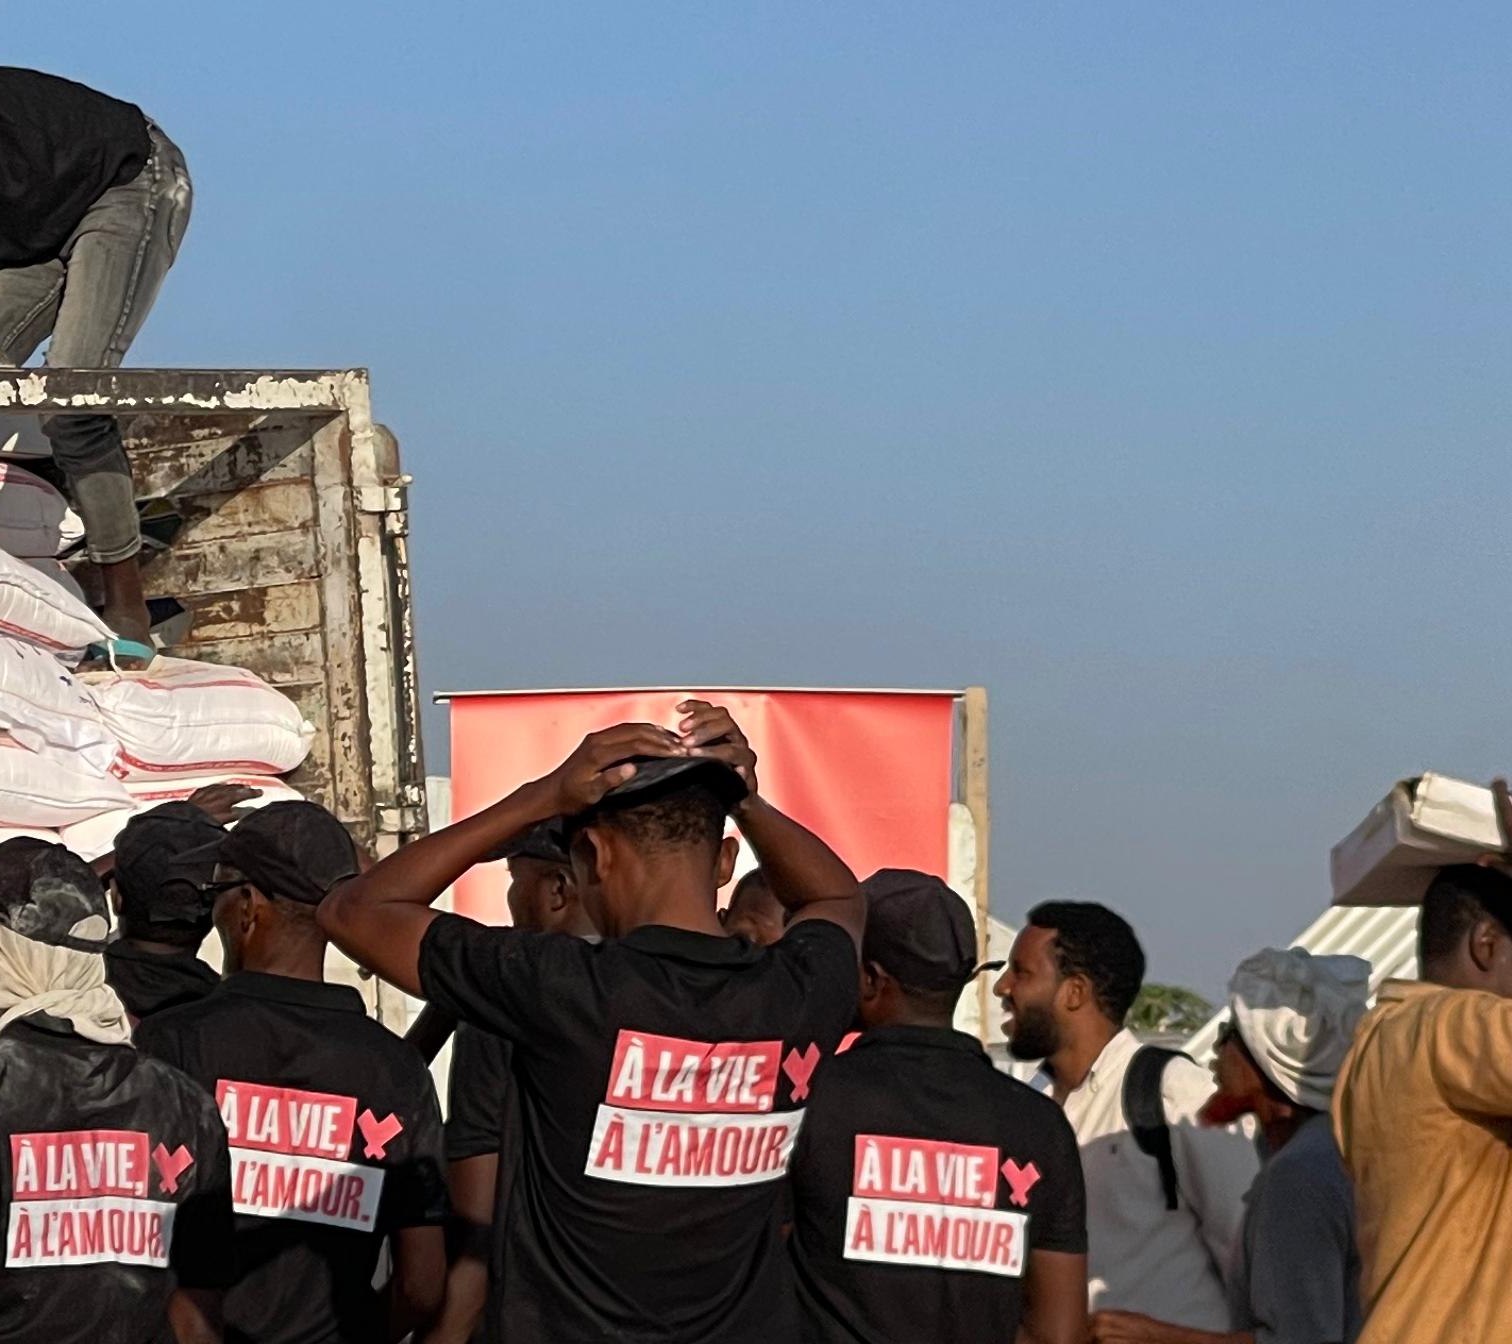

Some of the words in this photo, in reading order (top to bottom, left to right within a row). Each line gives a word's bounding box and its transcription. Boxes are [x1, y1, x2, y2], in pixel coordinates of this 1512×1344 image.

[613, 1037, 644, 1099] À
[651, 1051, 701, 1103] LA
[706, 1054, 772, 1111] VIE,
[220, 1086, 239, 1139] À
[246, 1096, 280, 1145] LA
[289, 1101, 348, 1159] VIE,
[594, 1113, 625, 1171] À
[16, 1140, 39, 1193] À
[46, 1144, 78, 1191] LA
[81, 1142, 144, 1195] VIE,
[234, 1161, 370, 1223] L'AMOUR.
[858, 1140, 883, 1192] À
[891, 1148, 927, 1194] LA
[936, 1152, 993, 1207] VIE,
[13, 1207, 32, 1259] À
[851, 1203, 875, 1252] À
[885, 1211, 1019, 1268] L'AMOUR.
